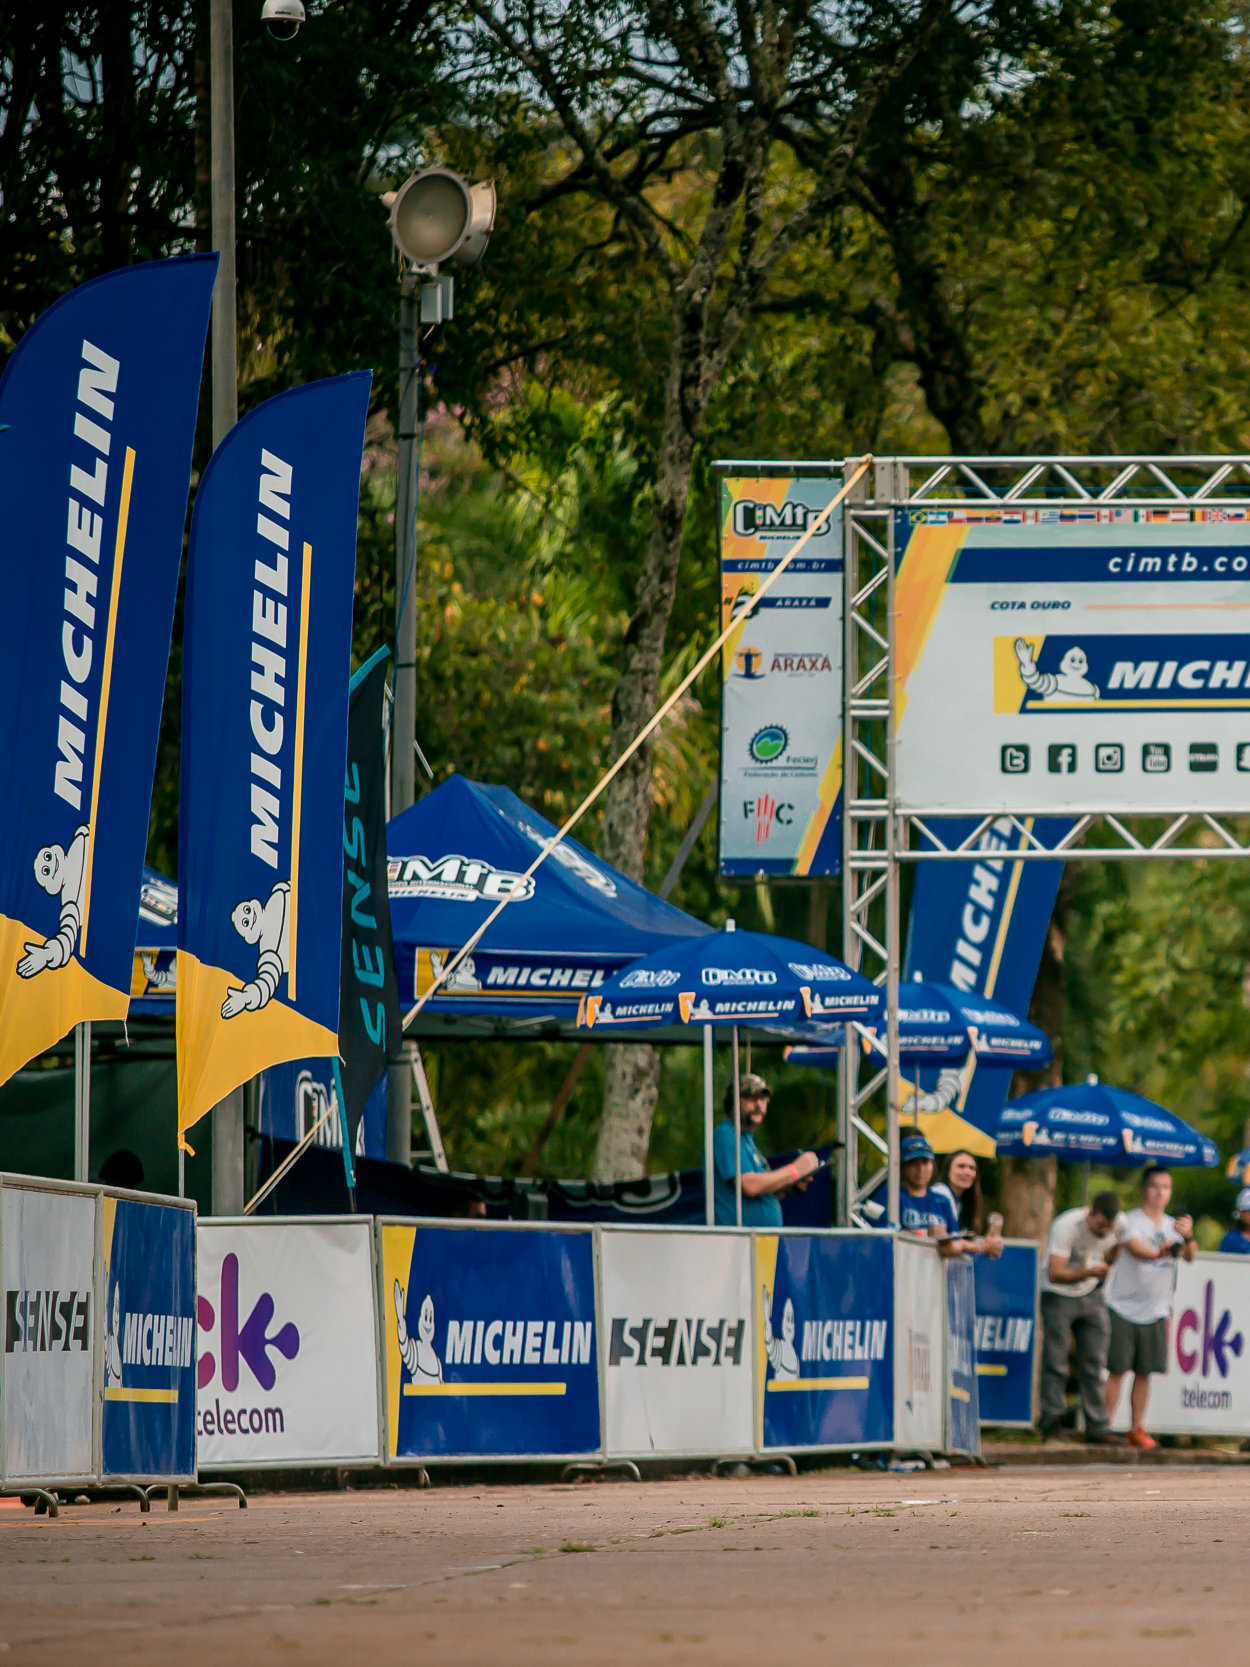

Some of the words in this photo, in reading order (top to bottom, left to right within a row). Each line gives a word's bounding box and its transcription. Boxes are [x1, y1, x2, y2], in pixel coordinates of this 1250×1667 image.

[54, 339, 120, 811] MICHELIN
[738, 560, 826, 571] cimtbom.br
[990, 601, 1026, 610] COTA
[1030, 601, 1072, 610] OURO
[250, 448, 293, 869] MICHELIN
[486, 966, 608, 988] MICHEL
[615, 1002, 674, 1017] MICHELIN
[715, 1000, 795, 1013] MICHELIN
[824, 995, 879, 1008] MICHELIN
[6, 1290, 91, 1353] SENSE
[122, 1312, 194, 1368] MICHELIN
[444, 1319, 593, 1366] MICHELIN
[609, 1318, 746, 1367] SENSE
[802, 1319, 888, 1362] MICHELIN
[1182, 1384, 1232, 1409] telecom
